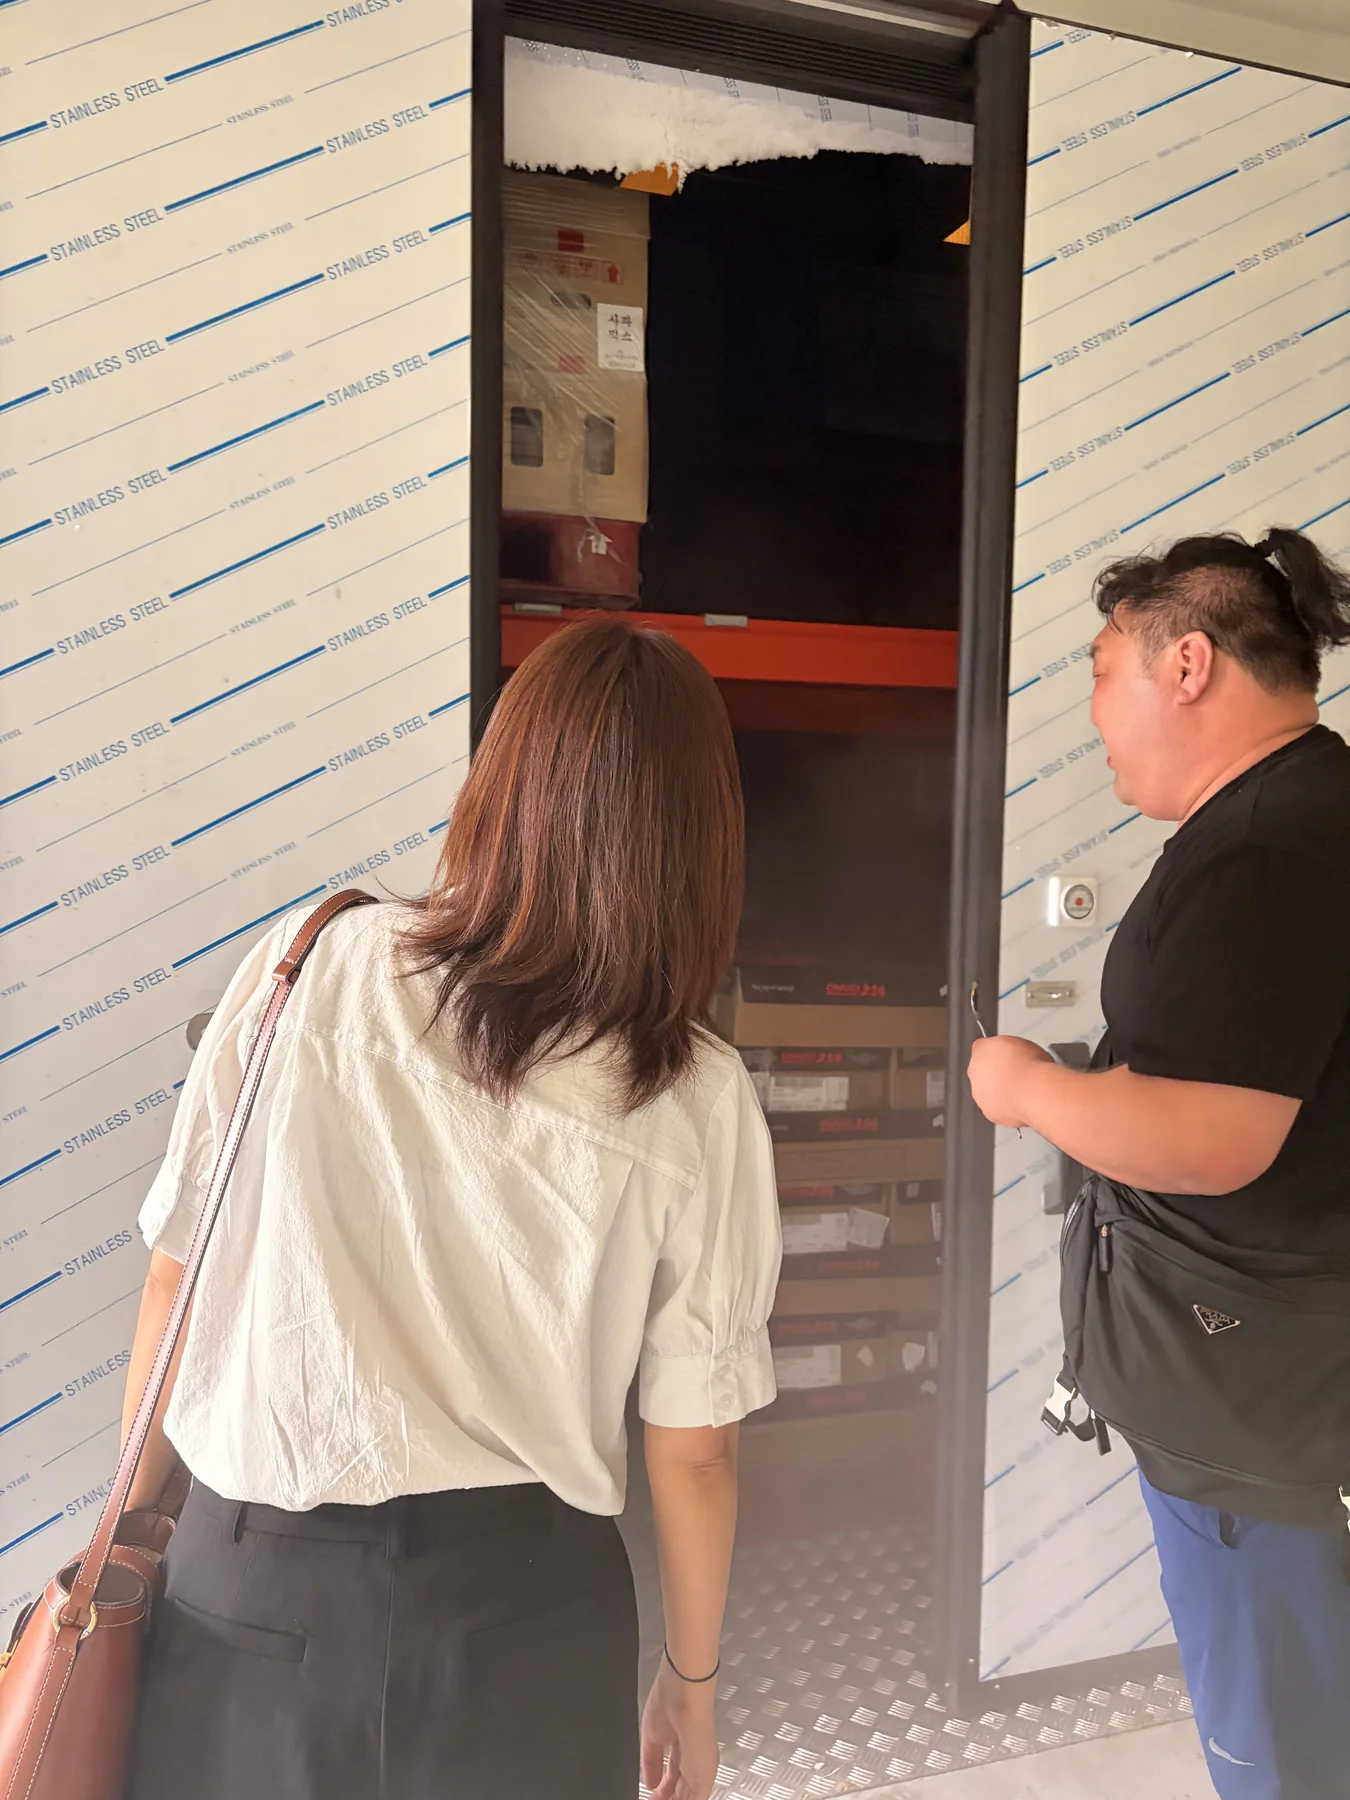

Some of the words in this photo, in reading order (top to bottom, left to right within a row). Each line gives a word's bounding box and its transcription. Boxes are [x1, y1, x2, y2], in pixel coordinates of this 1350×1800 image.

[50, 93, 120, 129] STAINLESS
[124, 78, 164, 102] STEEL
[326, 119, 389, 154] STAINLESS
[393, 105, 428, 129] STEEL
[1090, 111, 1136, 139] STAINLESS
[1061, 132, 1088, 151] STEEL
[50, 224, 120, 262] STAINLESS
[124, 208, 163, 232] STEEL
[327, 246, 389, 280] STAINLESS
[393, 230, 428, 253] STEEL
[1058, 240, 1084, 258] STEEL
[1087, 216, 1132, 246] STAINLESS
[1054, 346, 1080, 366] STEEL
[1081, 322, 1128, 352] STAINLESS
[51, 355, 122, 394] STAINLESS
[126, 339, 165, 364] STEEL
[327, 370, 389, 406] STAINLESS
[393, 354, 427, 378] STEEL
[54, 487, 124, 526] STAINLESS
[128, 470, 167, 494] STEEL
[327, 493, 389, 529] STAINLESS
[393, 476, 427, 500] STEEL
[56, 614, 126, 655] STAINLESS
[130, 597, 169, 621] STEEL
[328, 613, 389, 651] STAINLESS
[394, 596, 427, 620] STEEL
[59, 741, 127, 782] STAINLESS
[131, 722, 169, 747] STEEL
[328, 733, 390, 772] STAINLESS
[393, 716, 427, 739] STEEL
[61, 865, 129, 907] STAINLESS
[133, 846, 171, 870] STEEL
[328, 851, 390, 890] STAINLESS
[394, 833, 428, 856] STEEL
[62, 988, 130, 1031] STAINLESS
[134, 968, 171, 993] STEEL
[63, 1110, 131, 1154] STAINLESS
[135, 1088, 172, 1114] STEEL
[65, 1231, 132, 1276] STAINLESS
